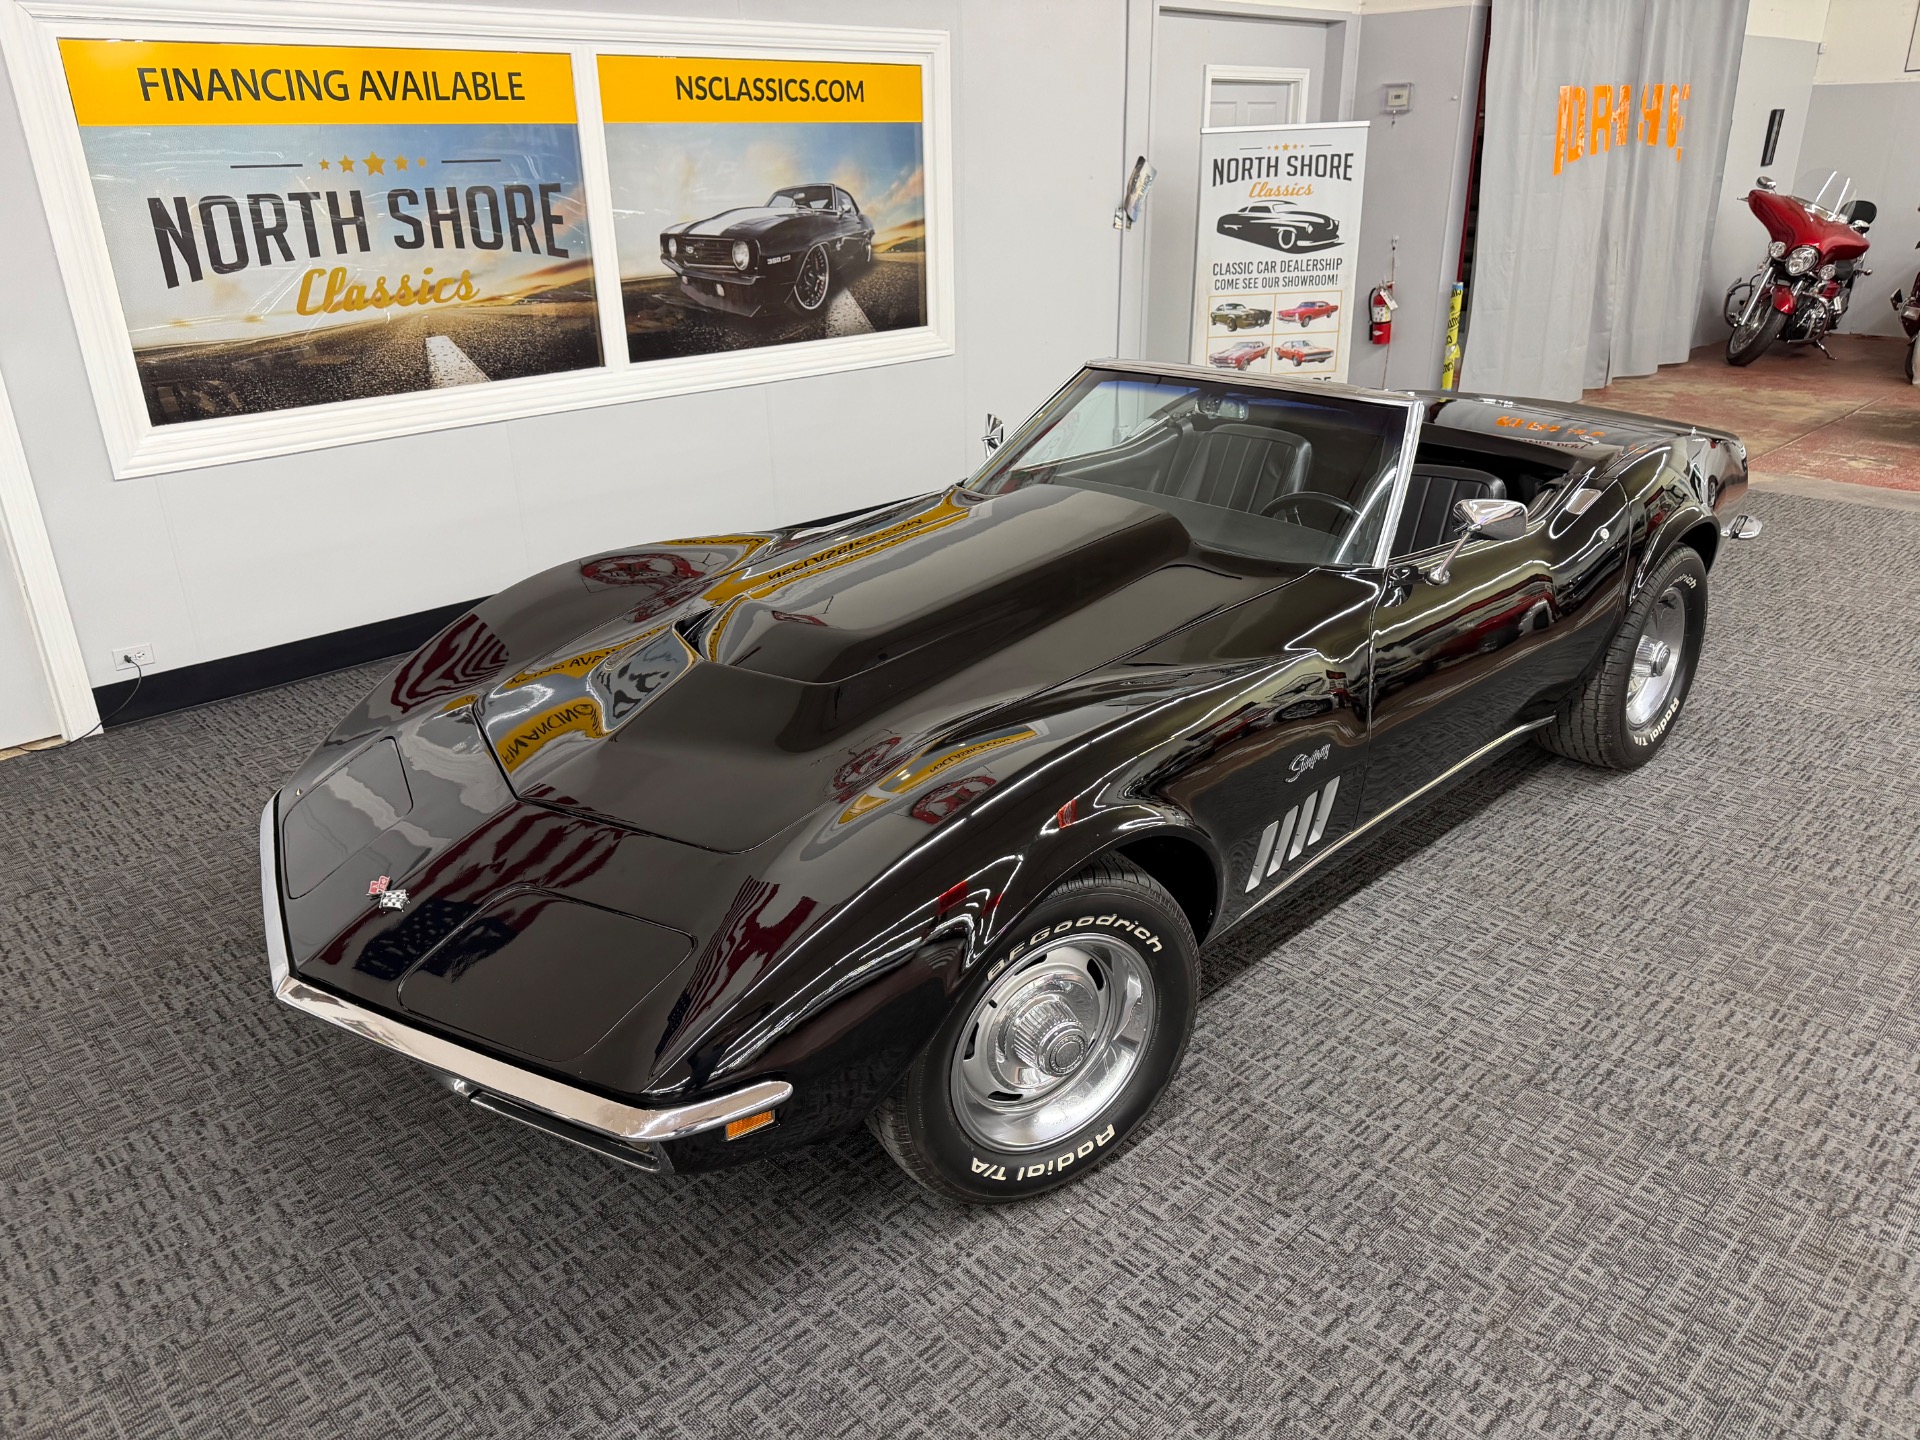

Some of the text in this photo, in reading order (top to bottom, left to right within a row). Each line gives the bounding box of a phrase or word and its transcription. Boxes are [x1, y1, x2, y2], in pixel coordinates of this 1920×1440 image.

[136, 66, 526, 102] FINANCING AVAILABLE
[675, 75, 865, 103] NSCLASSICS.COM
[1212, 153, 1354, 187] NORTH SHORE
[1248, 181, 1314, 198] Classics
[147, 183, 570, 289] NORTH SHORE
[1212, 257, 1343, 277] CLASSIC CAR DEALERSHIP
[1214, 274, 1339, 291] COME SEE OUR SHOWROOM!
[295, 266, 481, 316] Classics
[1650, 697, 1679, 743] Radial
[986, 913, 1163, 981] BFGoodrich
[970, 1123, 1116, 1181] Radial T/A
